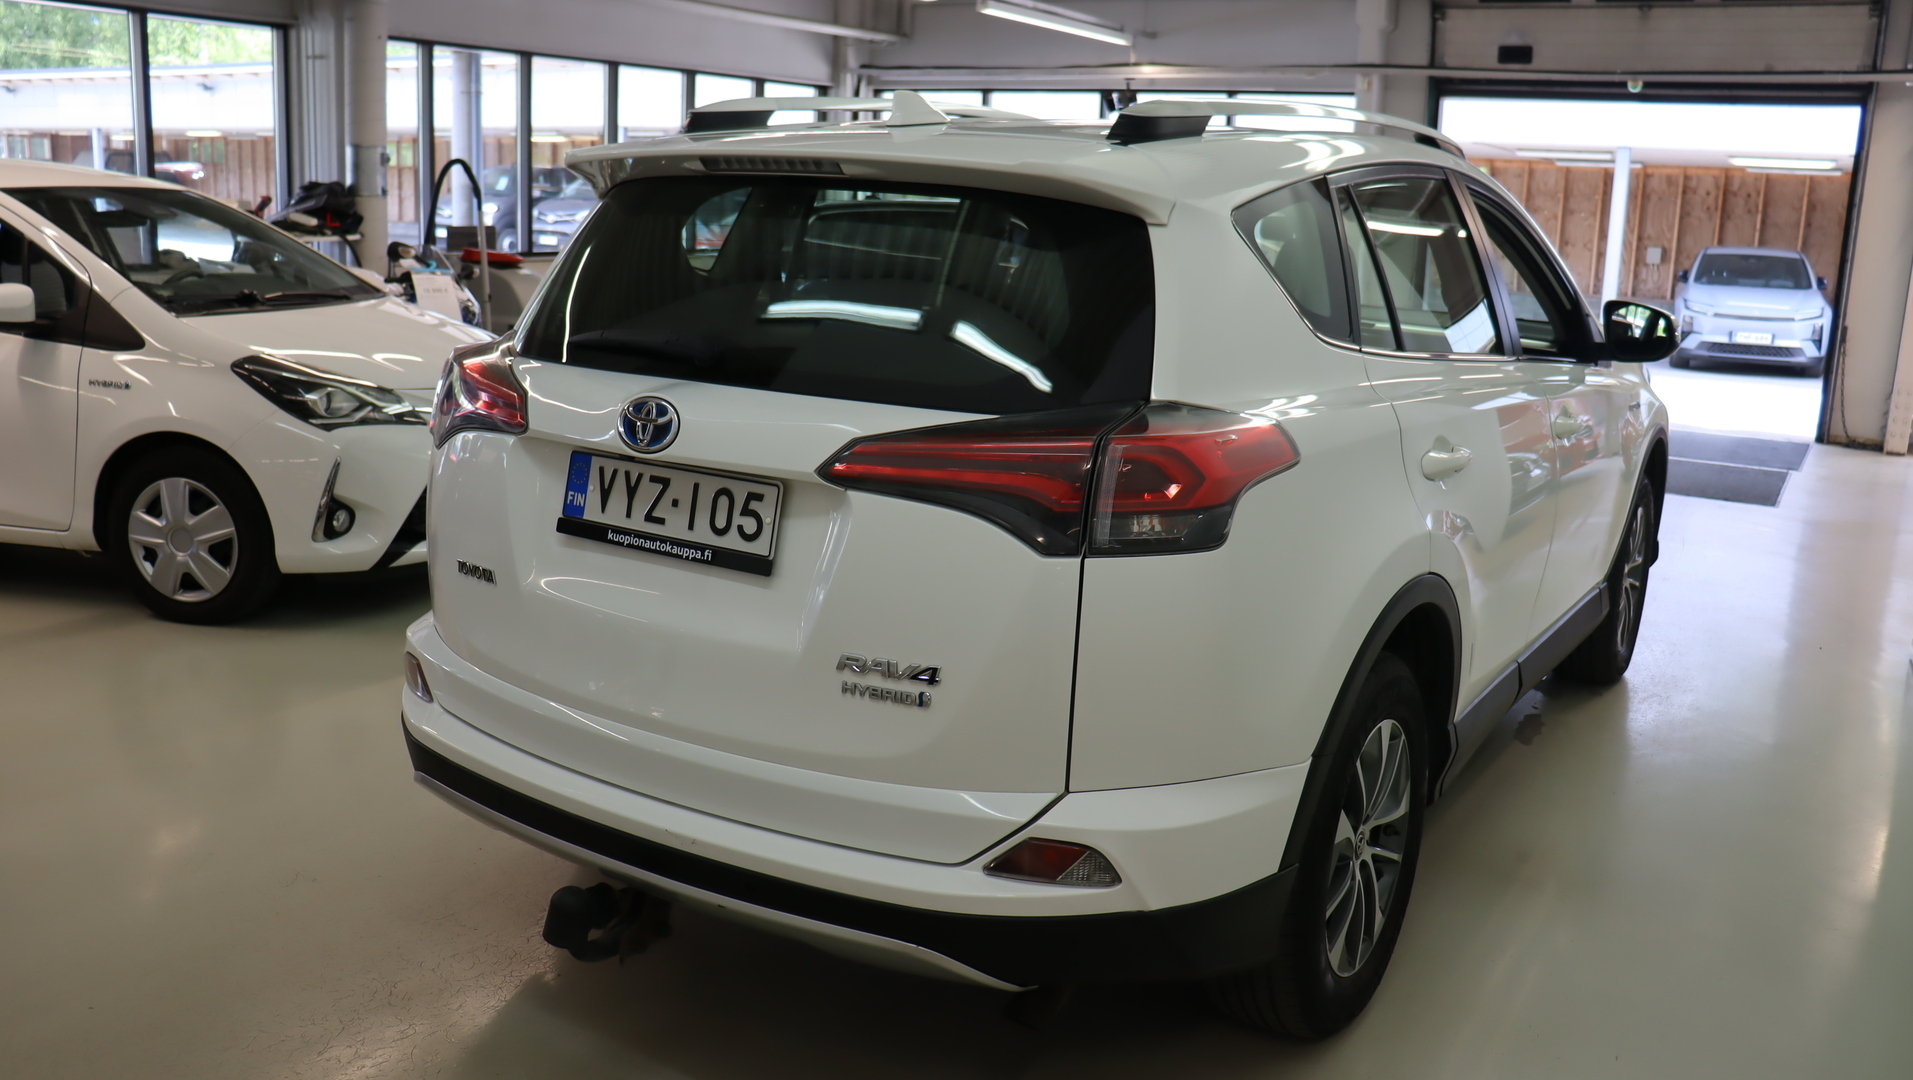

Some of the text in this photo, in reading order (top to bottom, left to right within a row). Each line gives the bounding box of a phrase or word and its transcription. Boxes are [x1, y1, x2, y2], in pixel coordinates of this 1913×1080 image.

[567, 491, 585, 507] FIN
[607, 529, 713, 561] kuopionautokauppa.fi
[456, 558, 497, 585] TOYOTA
[835, 651, 942, 687] RAV4
[841, 680, 917, 706] HYBRID
